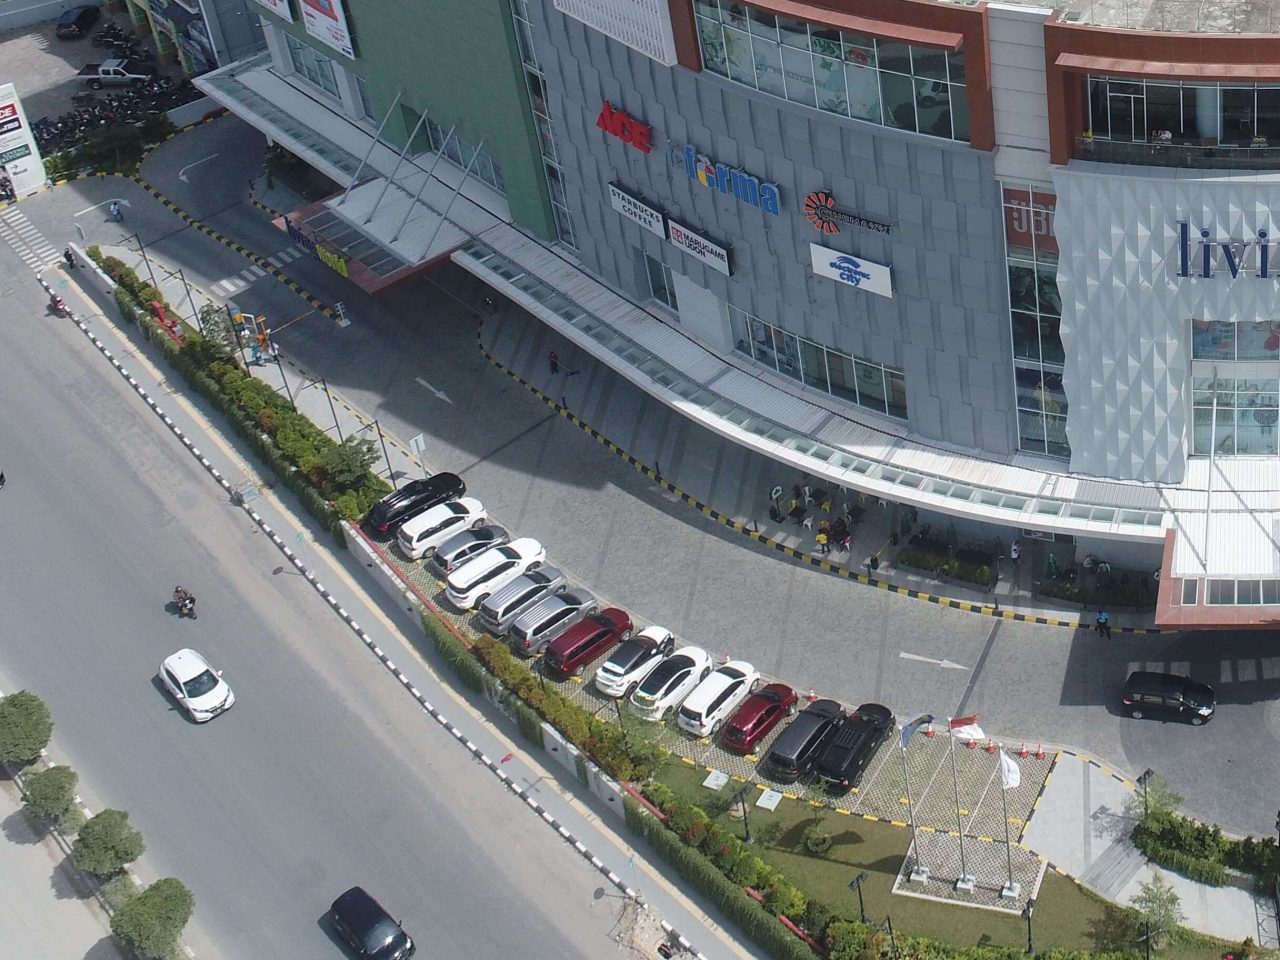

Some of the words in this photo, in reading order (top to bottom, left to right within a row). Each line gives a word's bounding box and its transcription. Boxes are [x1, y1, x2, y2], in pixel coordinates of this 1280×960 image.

[596, 99, 653, 154] ACE
[611, 188, 661, 223] STARBUCKS
[622, 204, 653, 228] COFFEE
[683, 232, 727, 262] MARUGAME
[683, 239, 707, 259] UDON
